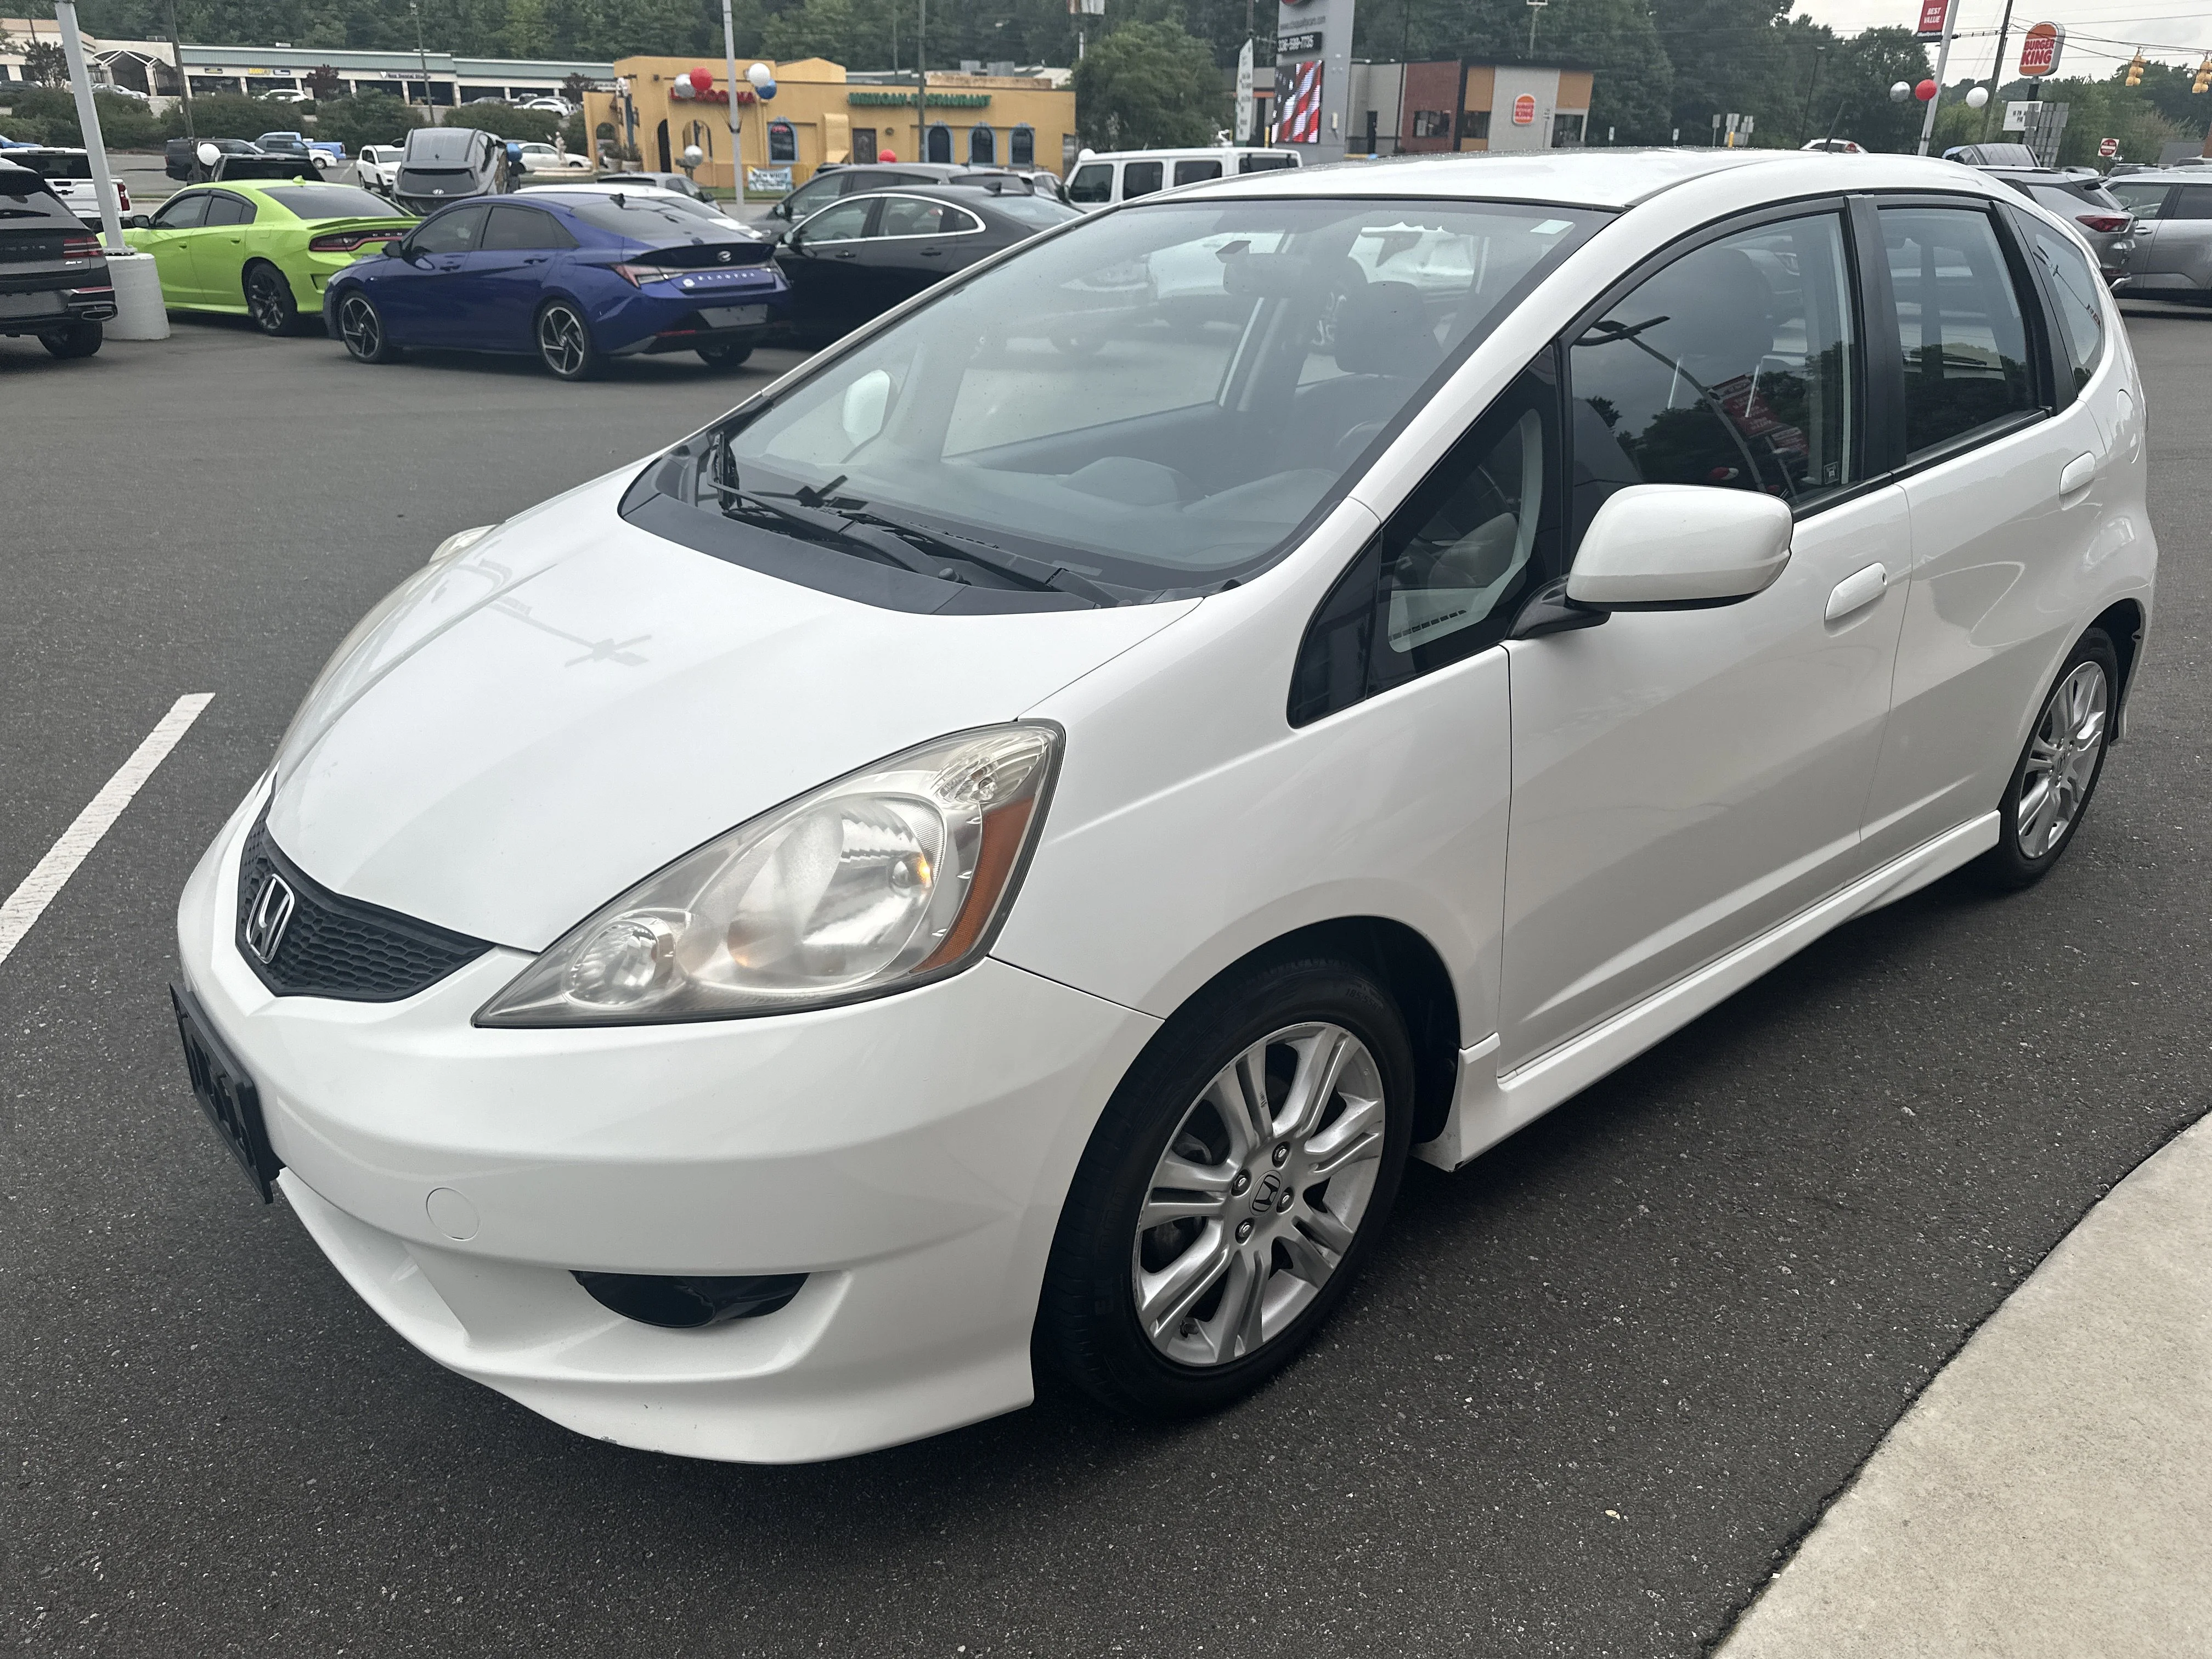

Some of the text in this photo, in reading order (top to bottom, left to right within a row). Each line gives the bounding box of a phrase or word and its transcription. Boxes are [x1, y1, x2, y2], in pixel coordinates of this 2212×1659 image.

[1927, 7, 1942, 15] BEST
[1923, 15, 1941, 24] VALUE
[2024, 39, 2055, 50] BURGER
[2021, 49, 2053, 65] KING
[910, 93, 992, 106] RSTAURANT
